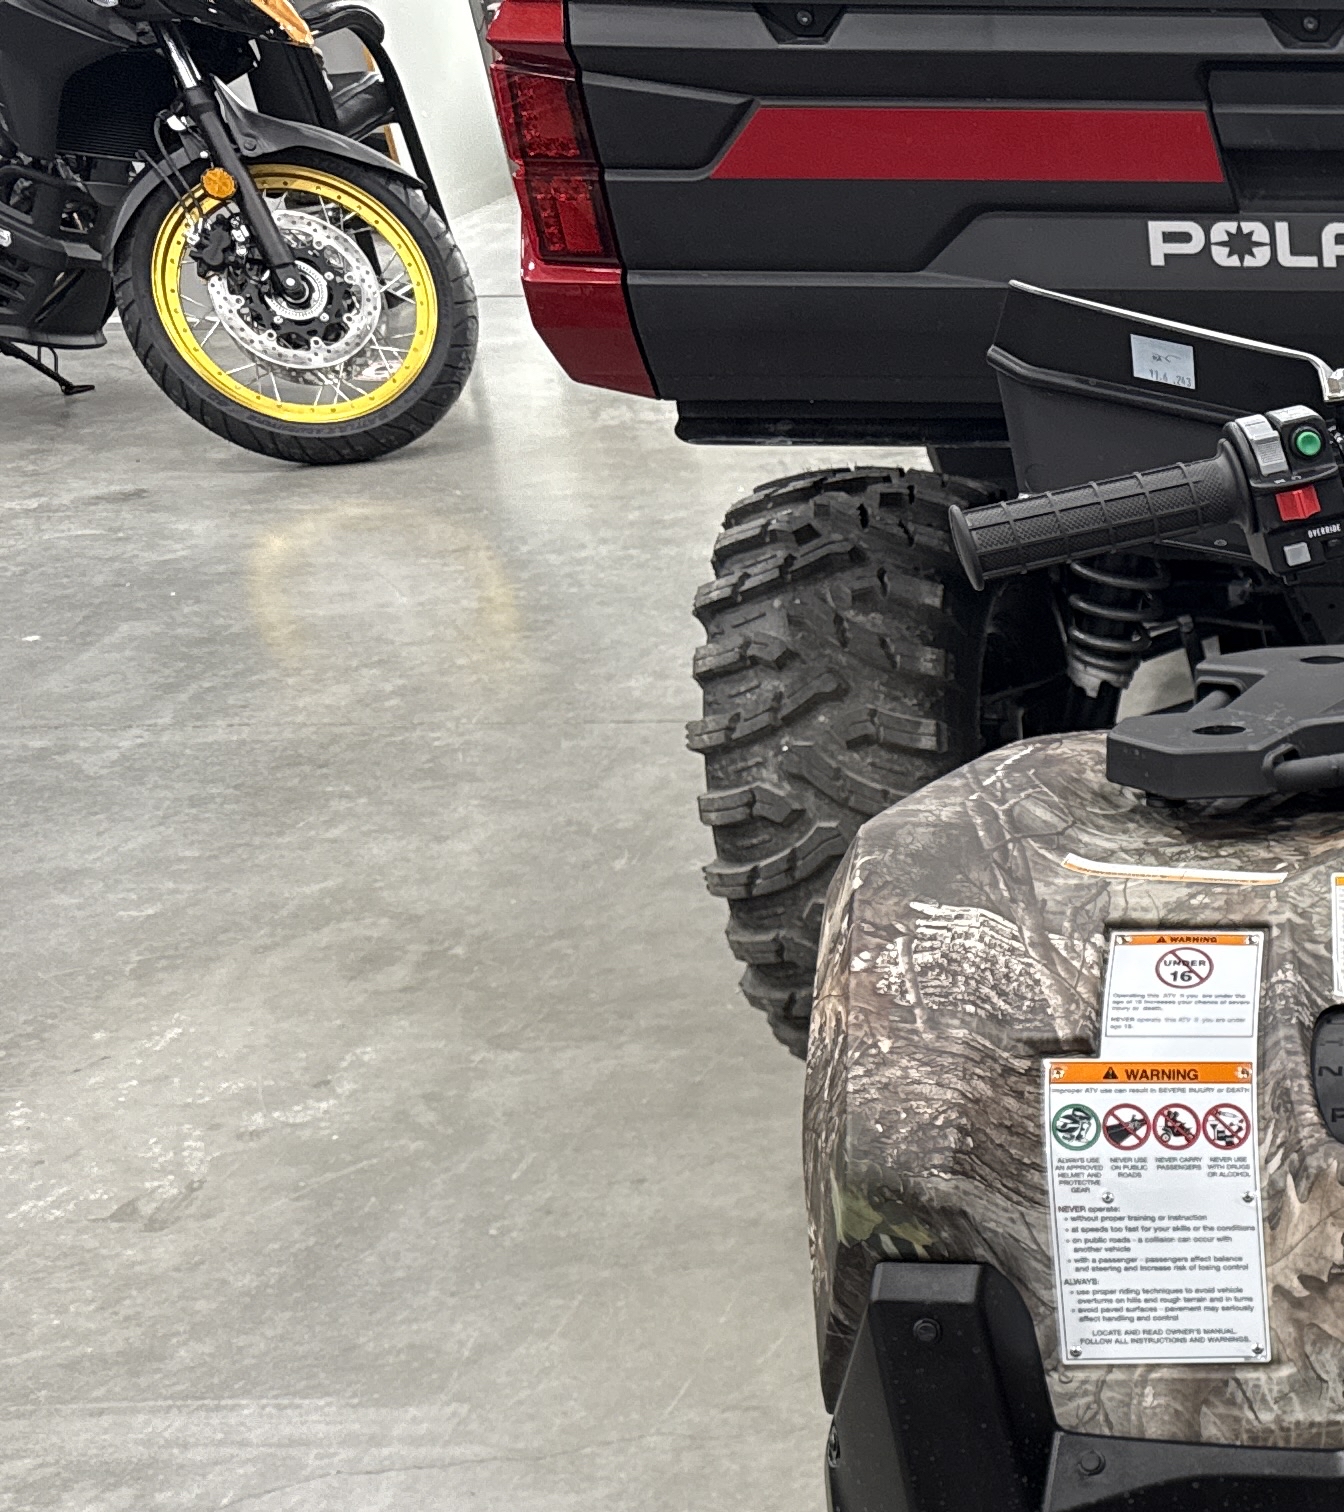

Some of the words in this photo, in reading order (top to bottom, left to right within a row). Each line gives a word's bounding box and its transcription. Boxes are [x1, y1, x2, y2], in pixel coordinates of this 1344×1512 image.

[1307, 523, 1341, 538] OVERRIDE
[1170, 971, 1193, 982] 16
[1125, 1069, 1198, 1081] WARNING
